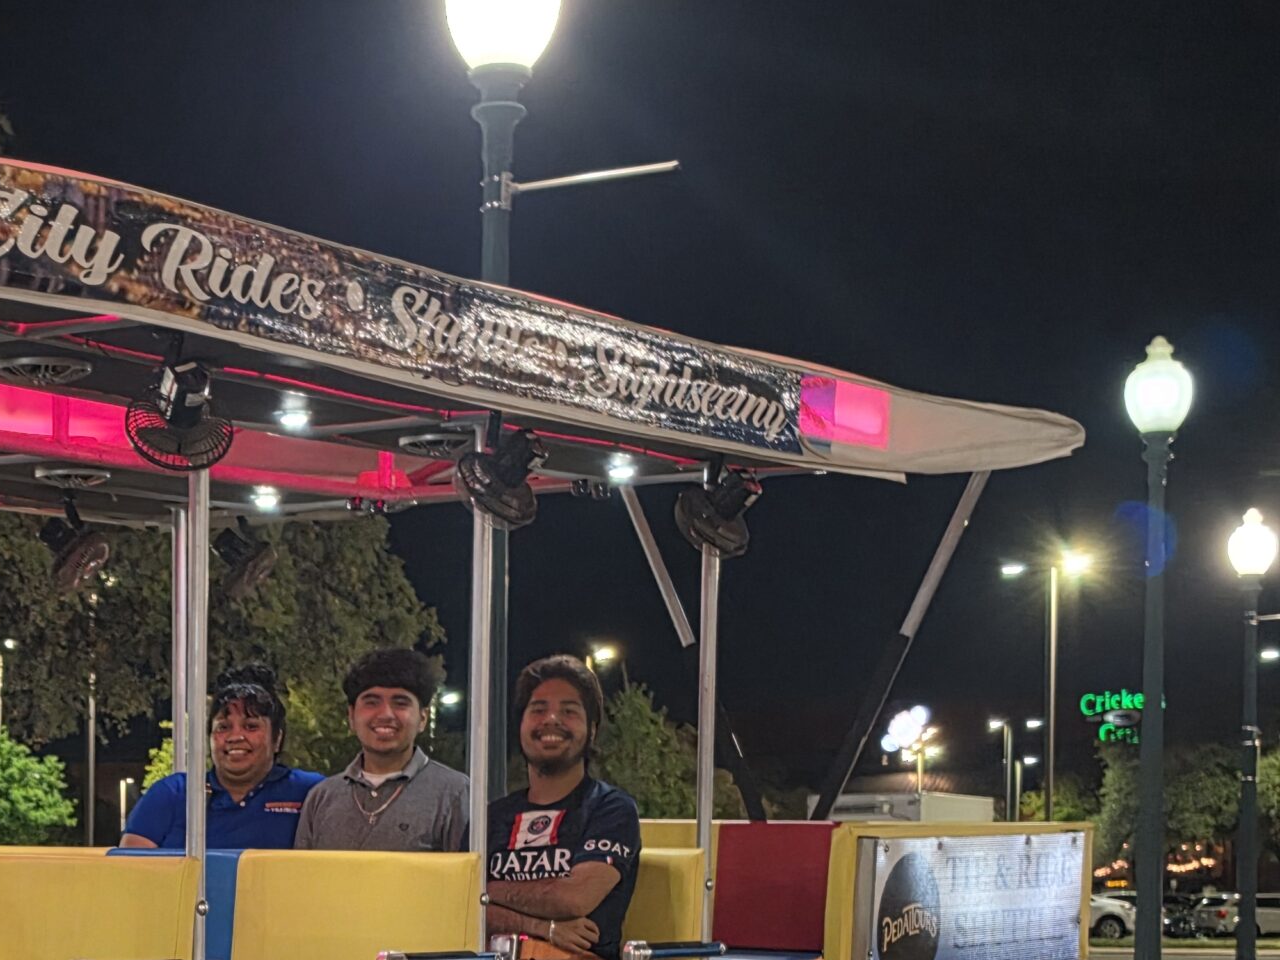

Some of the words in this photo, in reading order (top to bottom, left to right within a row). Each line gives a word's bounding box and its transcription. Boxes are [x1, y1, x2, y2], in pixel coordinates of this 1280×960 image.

[140, 222, 326, 321] Rides
[584, 340, 787, 442] Sightseeing
[1080, 688, 1166, 716] Cricke
[583, 839, 631, 858] GOAT
[490, 848, 572, 879] QATAR
